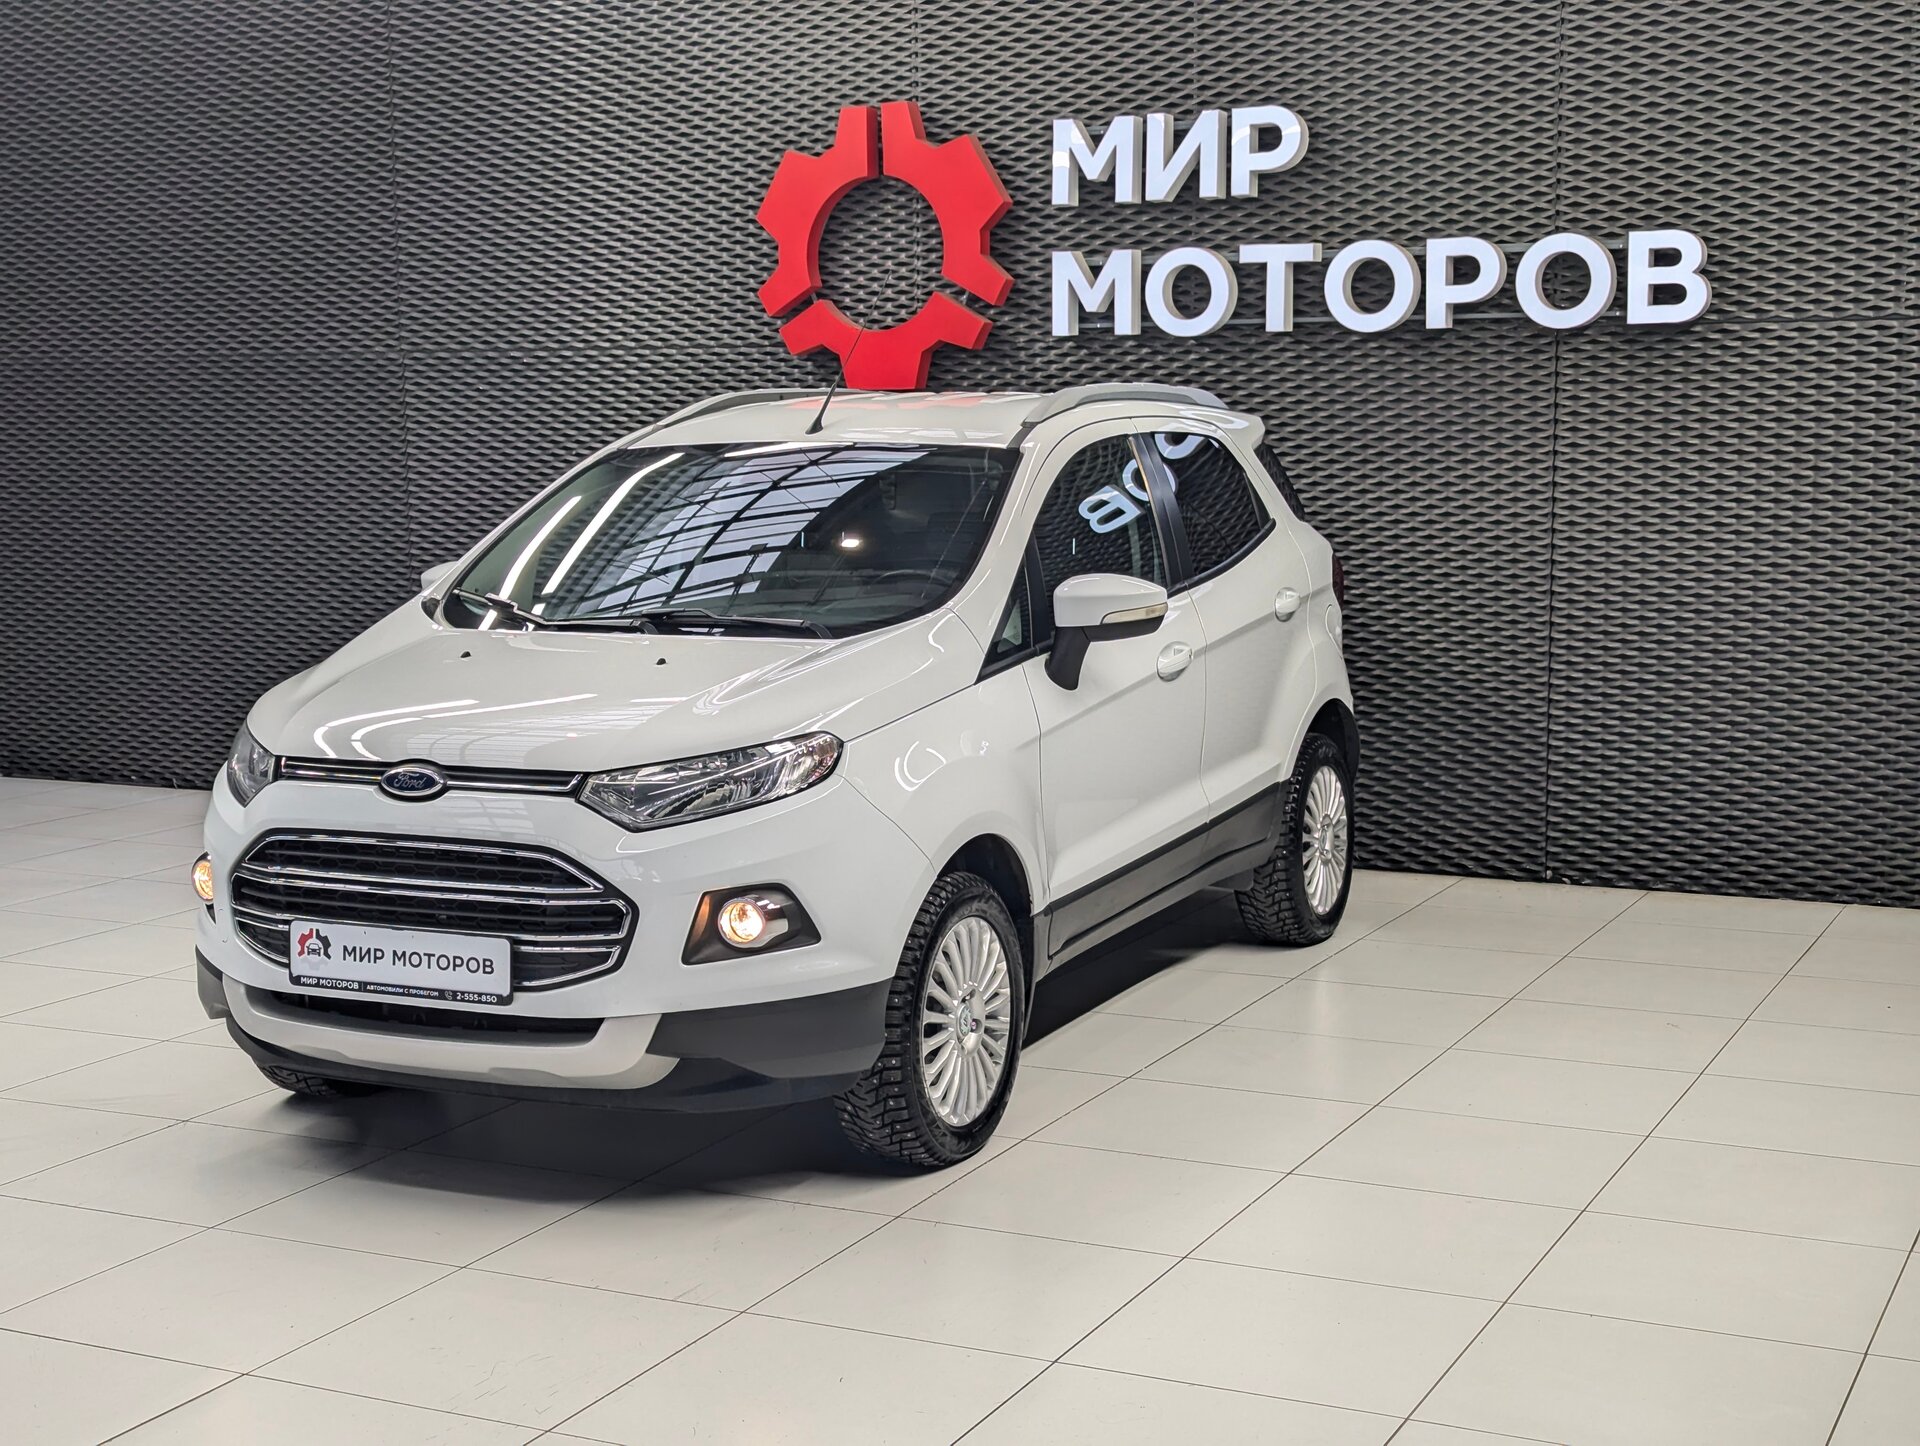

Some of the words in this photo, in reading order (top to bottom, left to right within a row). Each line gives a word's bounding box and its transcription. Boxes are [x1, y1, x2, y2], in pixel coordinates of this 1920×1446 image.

[1051, 105, 1309, 205] МИР
[1051, 229, 1711, 338] МОТОРОВ
[393, 770, 427, 788] Ford
[342, 945, 385, 964] МИР
[392, 949, 495, 975] МОТОРОВ
[300, 977, 318, 985] МИР
[319, 978, 359, 990] МОТОРОВ
[366, 984, 403, 993] АВТОМОБИЛИ
[409, 988, 439, 997] ПРОБЕГОМ
[456, 992, 498, 1003] 2-555-850
